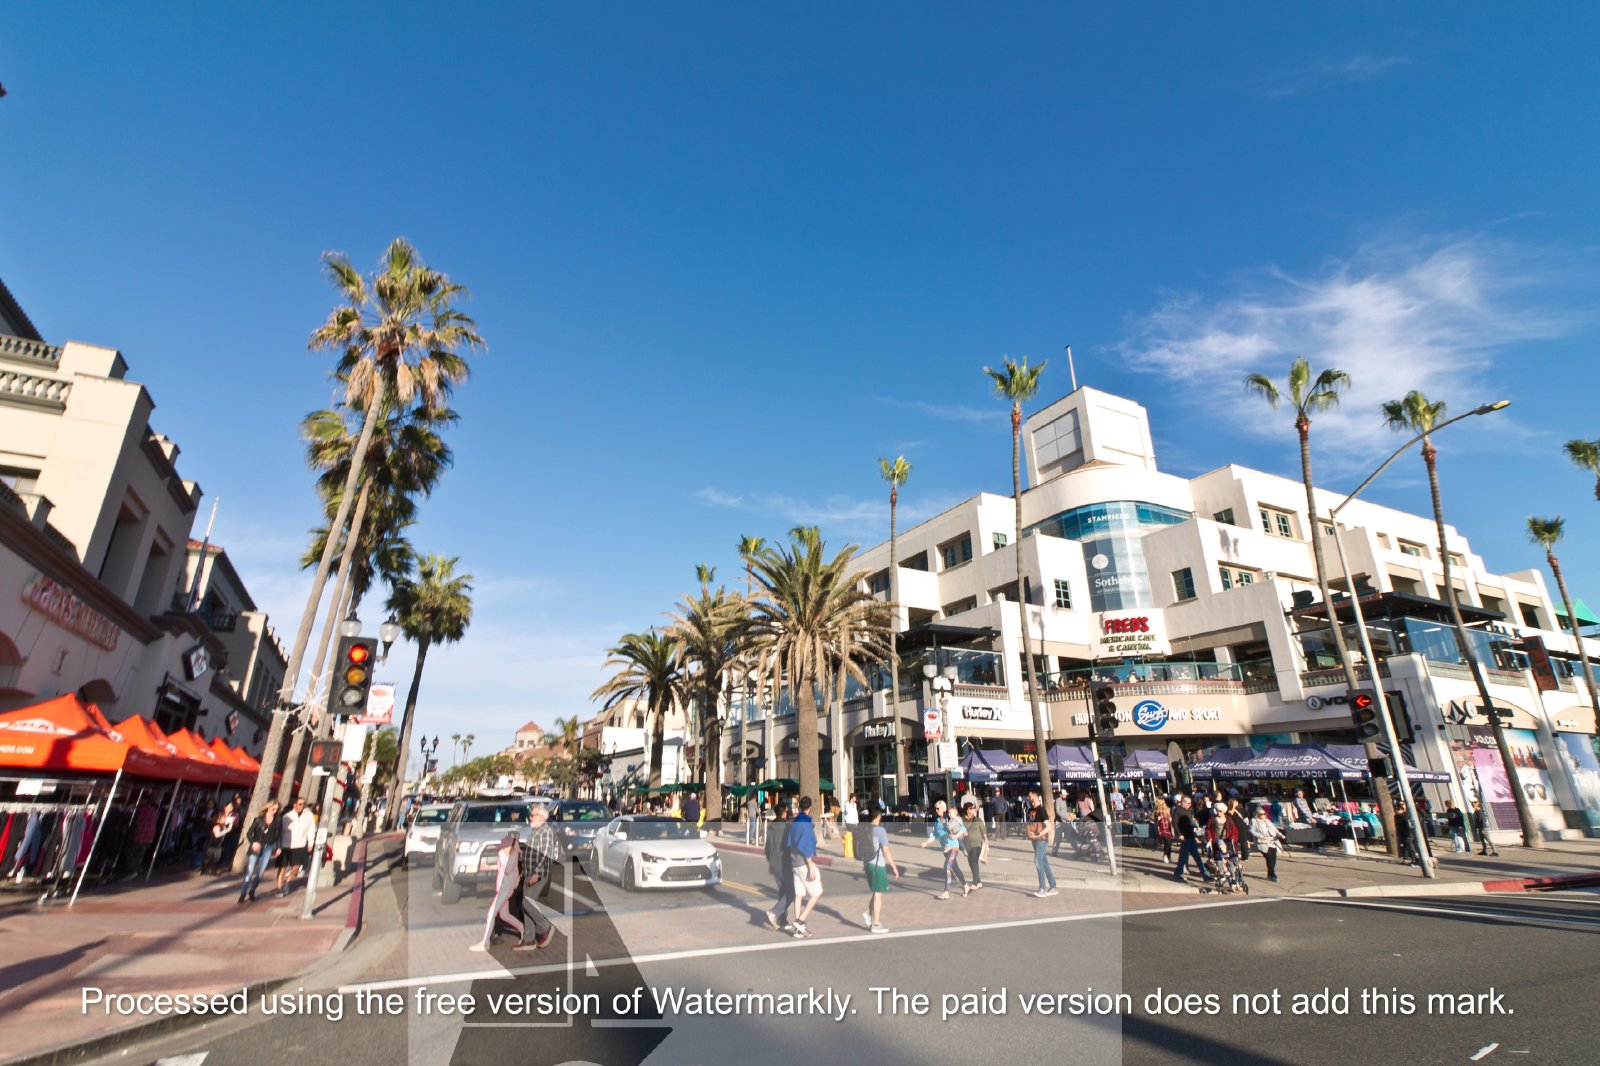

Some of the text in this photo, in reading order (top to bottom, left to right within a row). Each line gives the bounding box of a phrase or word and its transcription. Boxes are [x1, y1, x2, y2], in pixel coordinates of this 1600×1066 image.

[1168, 709, 1188, 721] AND
[1190, 707, 1223, 721] SPORT
[1126, 770, 1144, 778] SPORT
[1220, 770, 1267, 778] HUNTINGTON
[1301, 770, 1328, 778] SPORT
